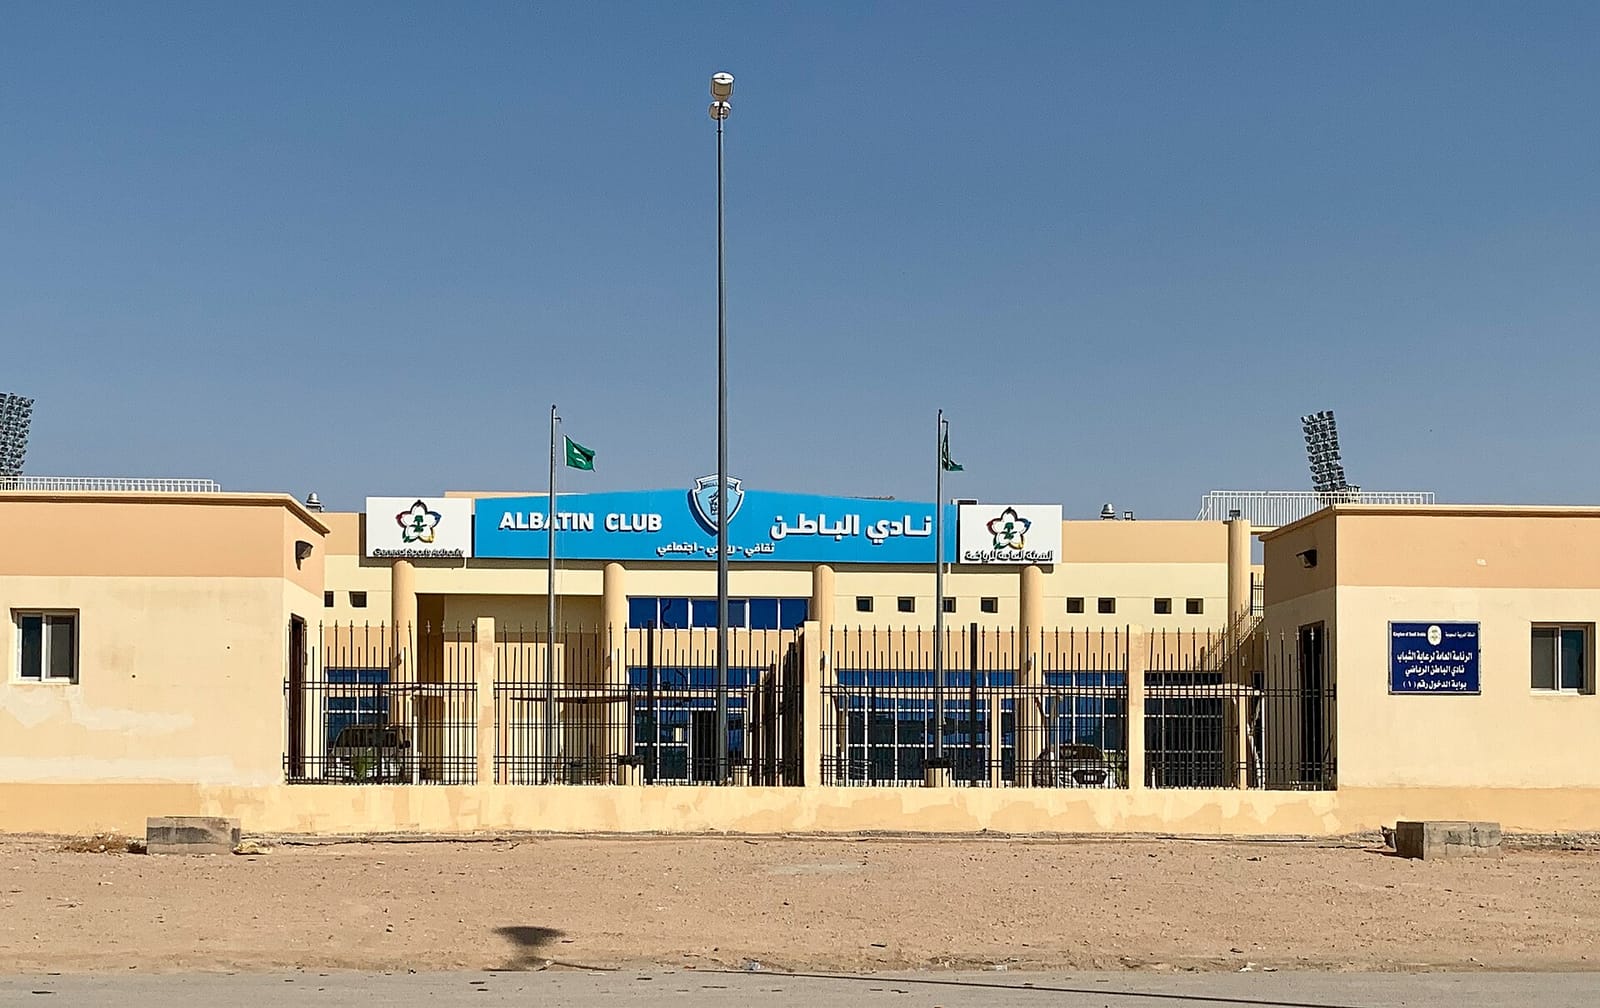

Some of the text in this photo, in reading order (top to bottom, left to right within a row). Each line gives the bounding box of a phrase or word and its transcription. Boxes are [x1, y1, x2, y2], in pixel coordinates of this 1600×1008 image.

[499, 512, 662, 532] ALBATIN CLUB
[770, 513, 932, 544] نادي الباطن
[656, 541, 698, 557] اجتماعي
[743, 542, 775, 557] ثقافي
[1405, 664, 1465, 677] نادي الباطن الرياضي
